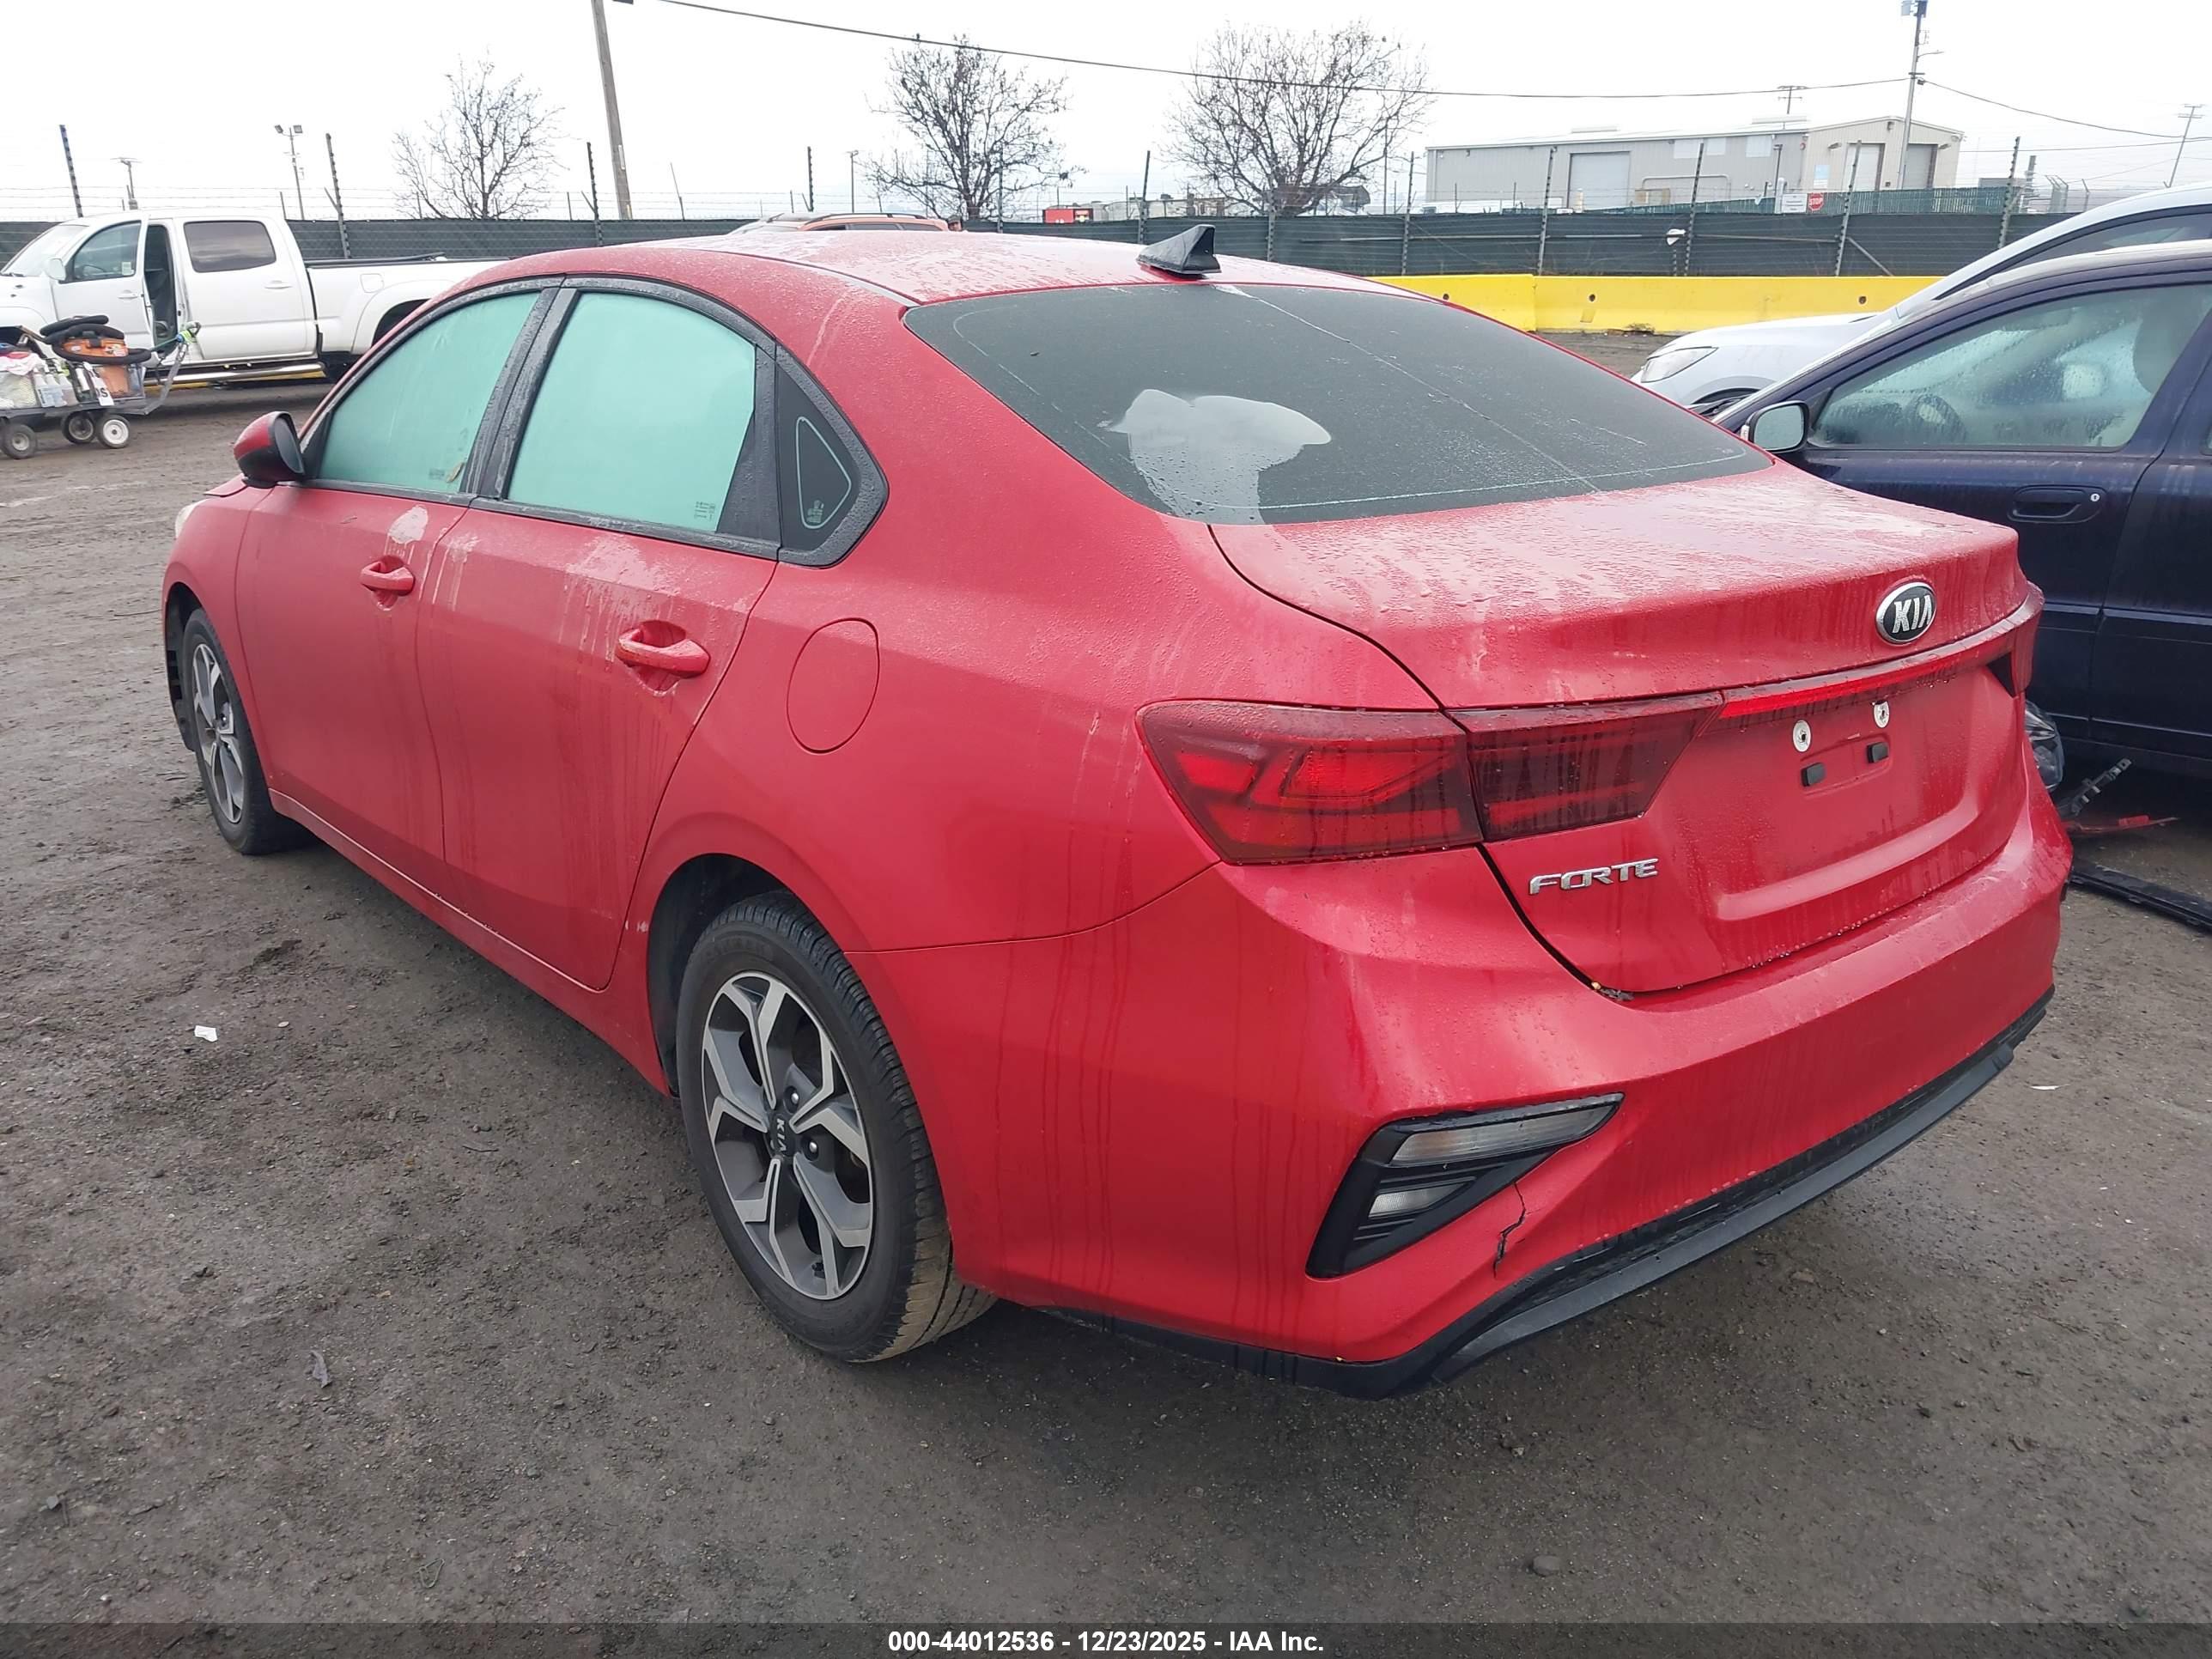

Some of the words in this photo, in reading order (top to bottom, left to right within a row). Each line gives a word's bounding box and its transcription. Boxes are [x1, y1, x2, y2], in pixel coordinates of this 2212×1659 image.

[1892, 594, 1932, 634] KIA
[1529, 858, 1658, 895] FORTE
[776, 1118, 787, 1152] KIA
